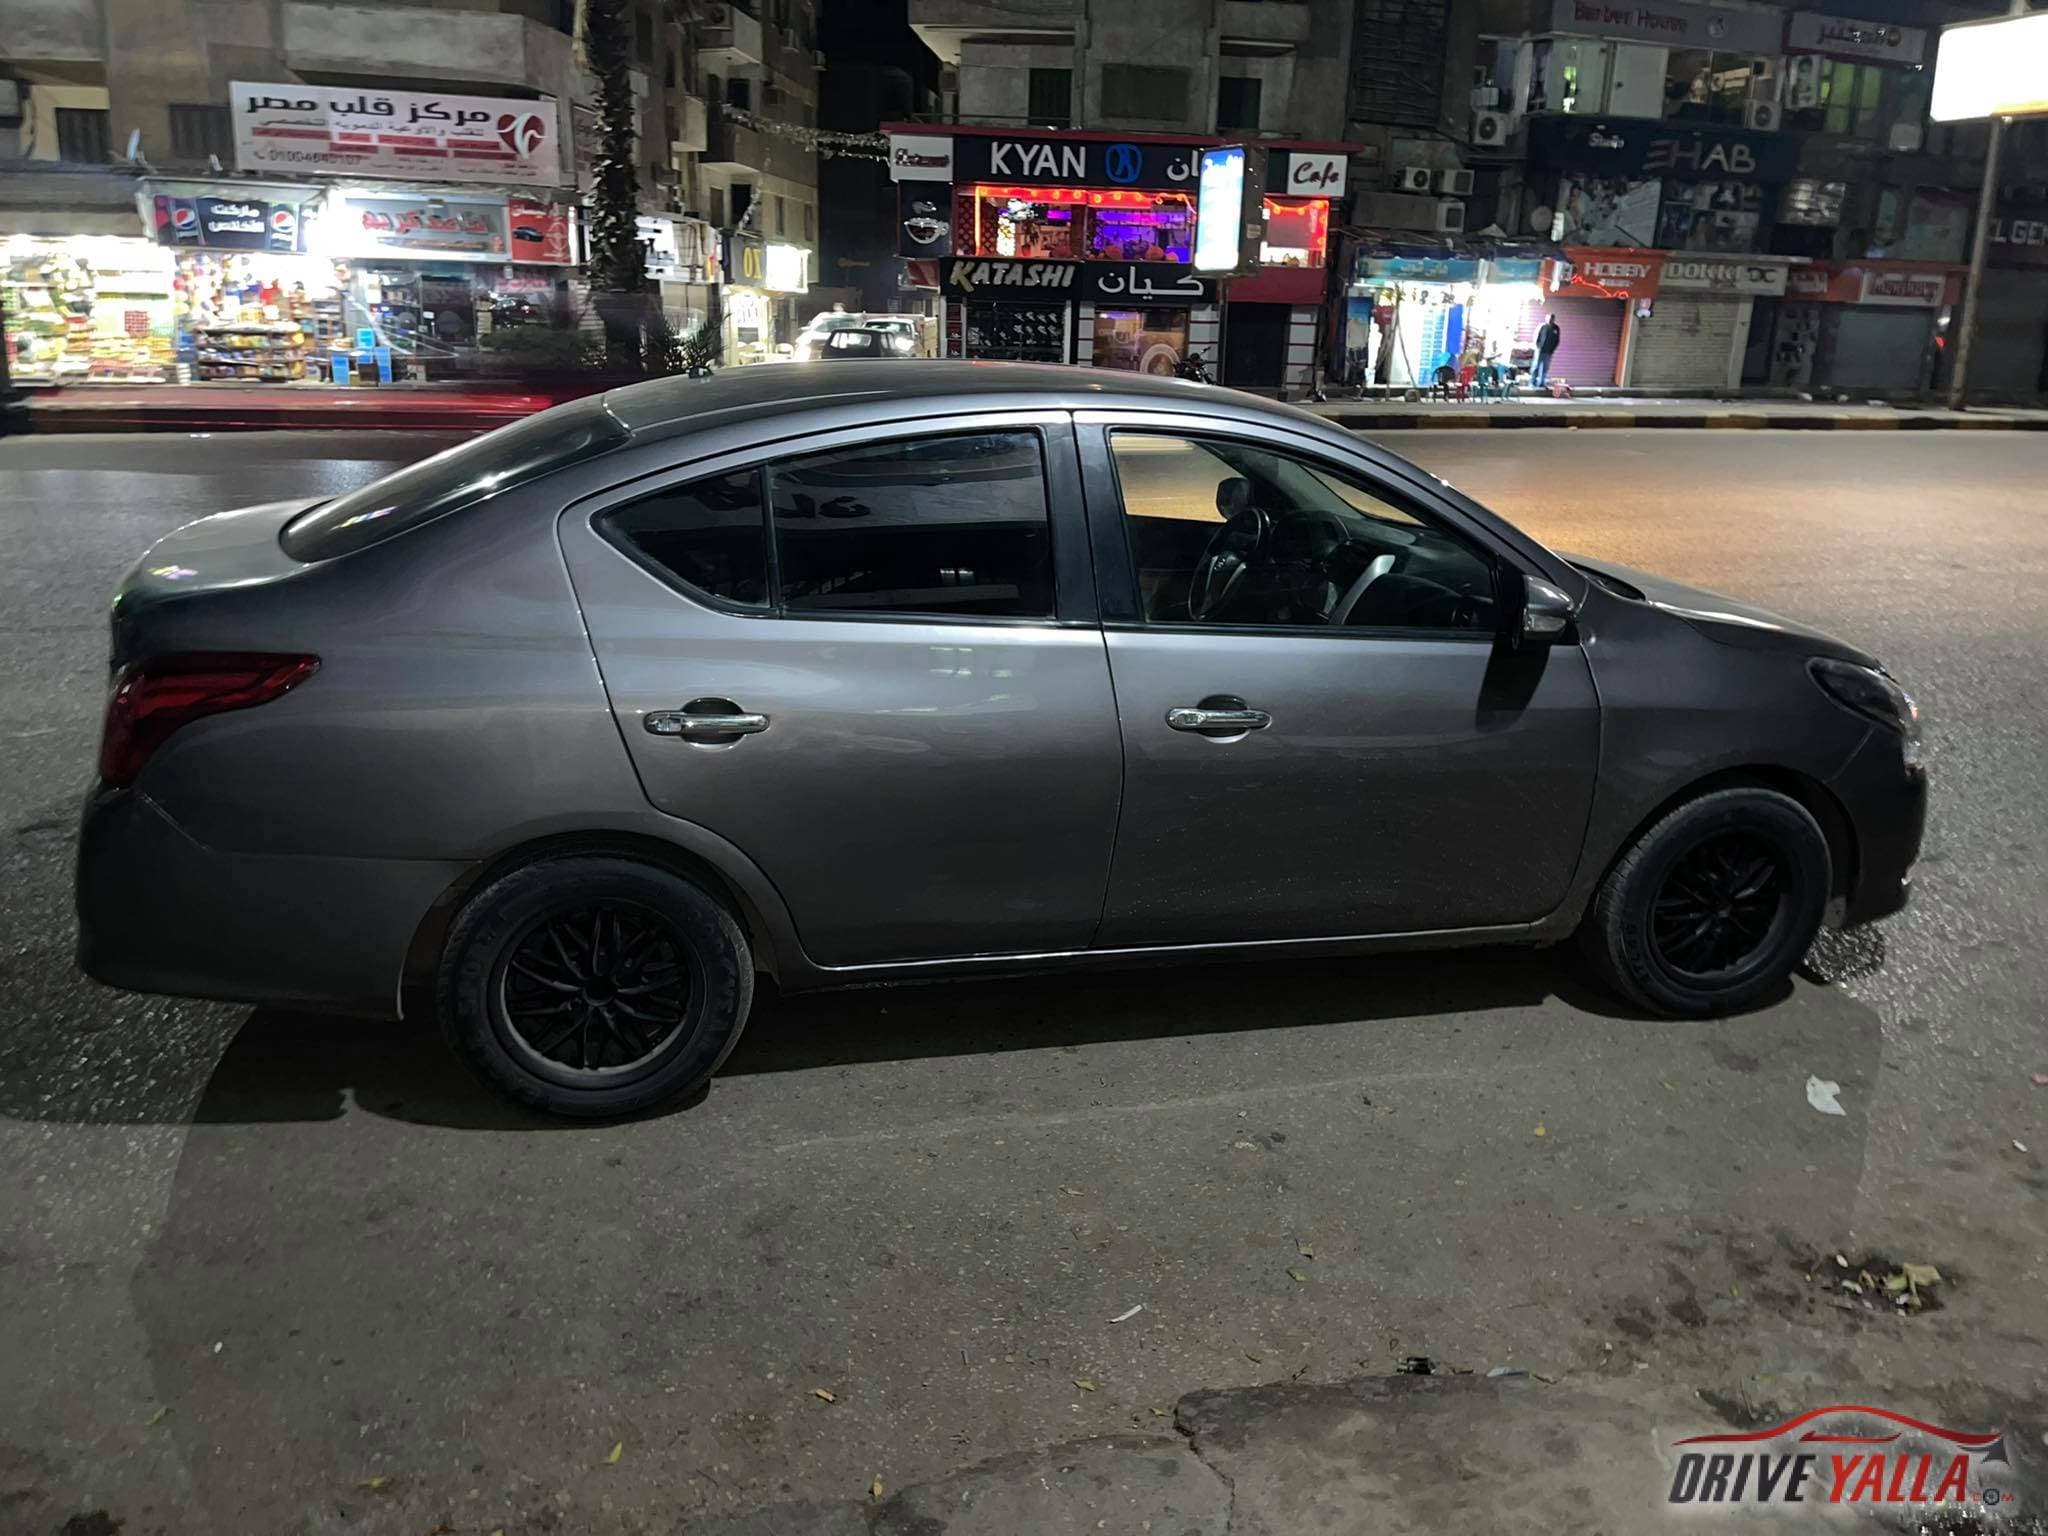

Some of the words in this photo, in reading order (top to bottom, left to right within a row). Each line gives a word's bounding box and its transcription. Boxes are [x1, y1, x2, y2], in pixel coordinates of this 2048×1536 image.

[247, 97, 318, 113] مصر
[330, 97, 395, 117] قلب
[408, 101, 491, 126] مركز
[991, 141, 1087, 178] KYAN
[1293, 161, 1340, 190] Cafe
[949, 260, 1077, 293] KATASHI
[1097, 265, 1205, 300] كيان
[1584, 262, 1652, 279] HOBBY
